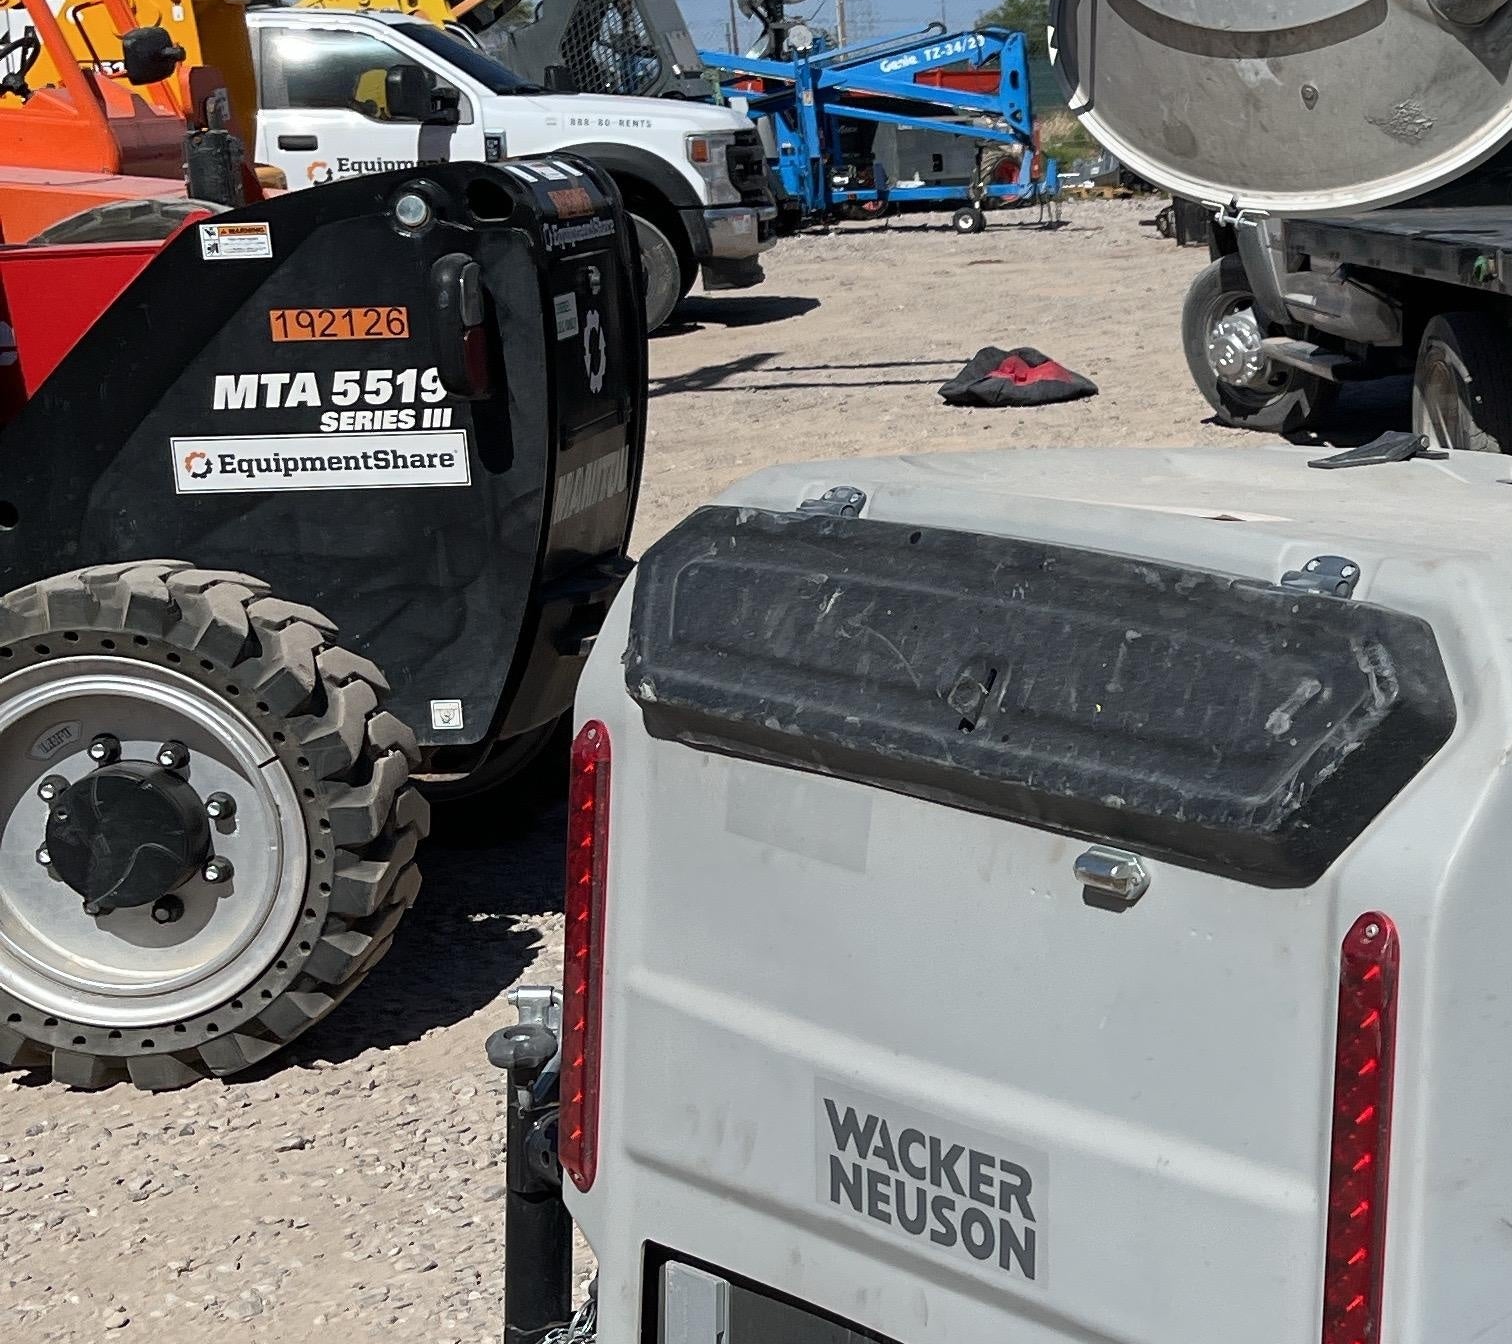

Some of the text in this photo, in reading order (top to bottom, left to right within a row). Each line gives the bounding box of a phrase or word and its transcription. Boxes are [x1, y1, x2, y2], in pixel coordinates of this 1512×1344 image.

[880, 55, 918, 73] Genie
[273, 308, 406, 339] 192126
[213, 367, 448, 411] MTA 5519
[319, 407, 453, 433] SERIES III
[218, 449, 456, 479] EquipmentShare
[823, 1097, 1037, 1223] WACKER
[829, 1153, 1036, 1281] NEUSON
